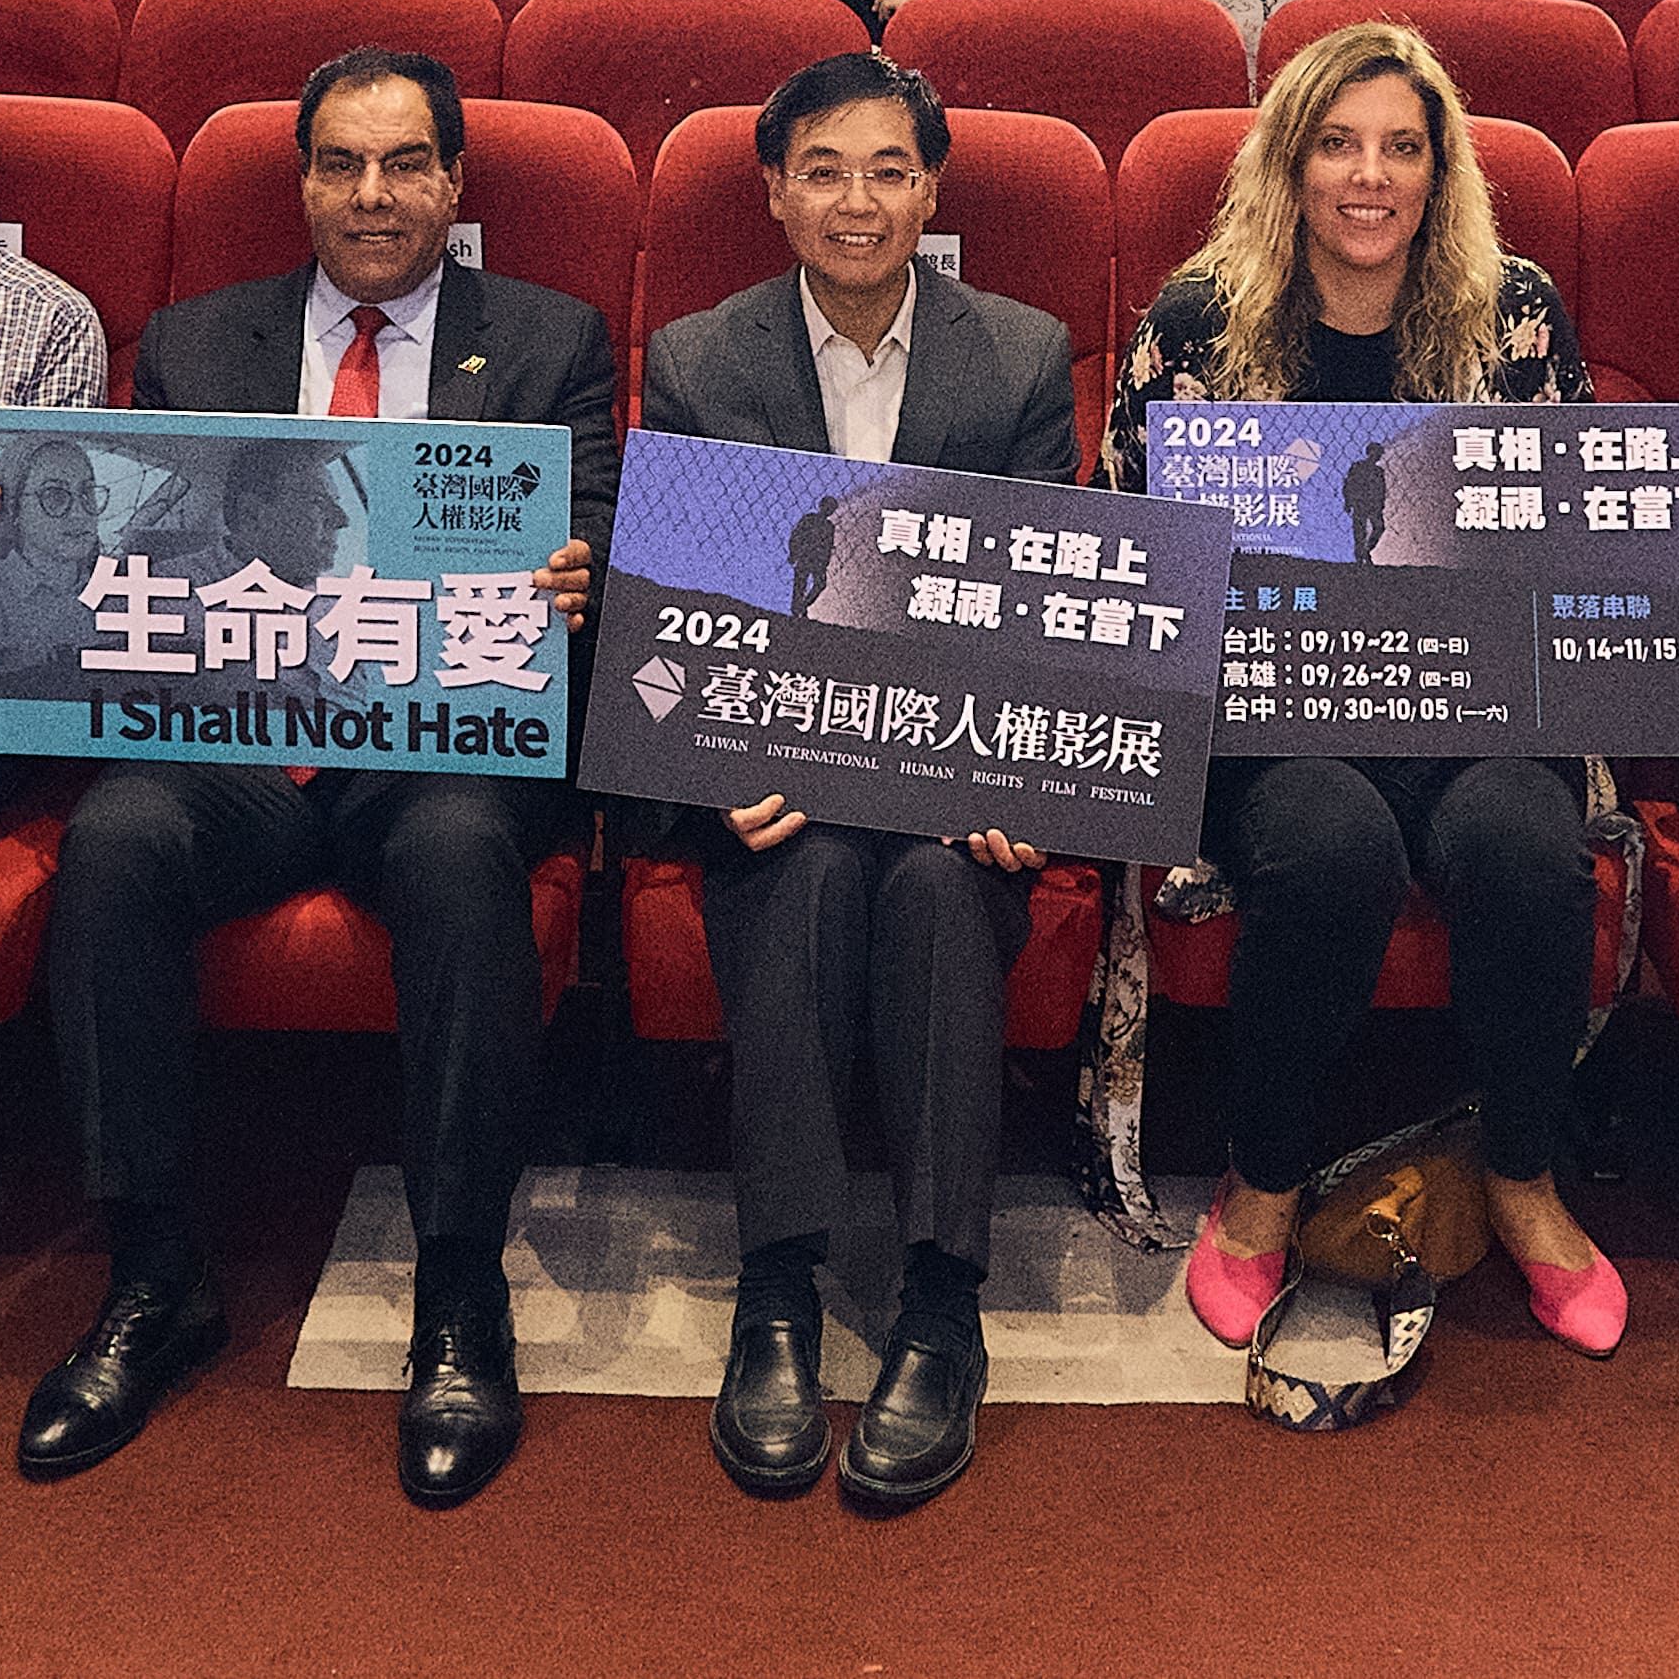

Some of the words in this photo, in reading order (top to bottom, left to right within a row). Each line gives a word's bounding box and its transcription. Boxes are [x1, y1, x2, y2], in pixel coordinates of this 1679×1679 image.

[1163, 417, 1262, 448] 2024
[414, 442, 493, 469] 2024
[1161, 454, 1300, 488] 臺灣國際
[412, 471, 525, 501] 臺灣國際
[413, 504, 523, 533] 人權影展
[77, 554, 553, 692] 生命有愛
[1552, 593, 1652, 620] 聚落串聯
[655, 607, 771, 654] 2024
[90, 696, 104, 739] I
[119, 689, 271, 748] Shall
[286, 701, 395, 753] Not
[407, 701, 550, 760] Hate
[697, 663, 1164, 780] 臺灣國際人權影展
[694, 733, 749, 753] TAIWAN
[766, 743, 879, 770] INTERNATIONAL
[899, 761, 955, 781] HUMAN
[971, 770, 1024, 789] RIGHTS
[1041, 779, 1077, 797] FILM
[1089, 786, 1155, 807] FESTIVAL
